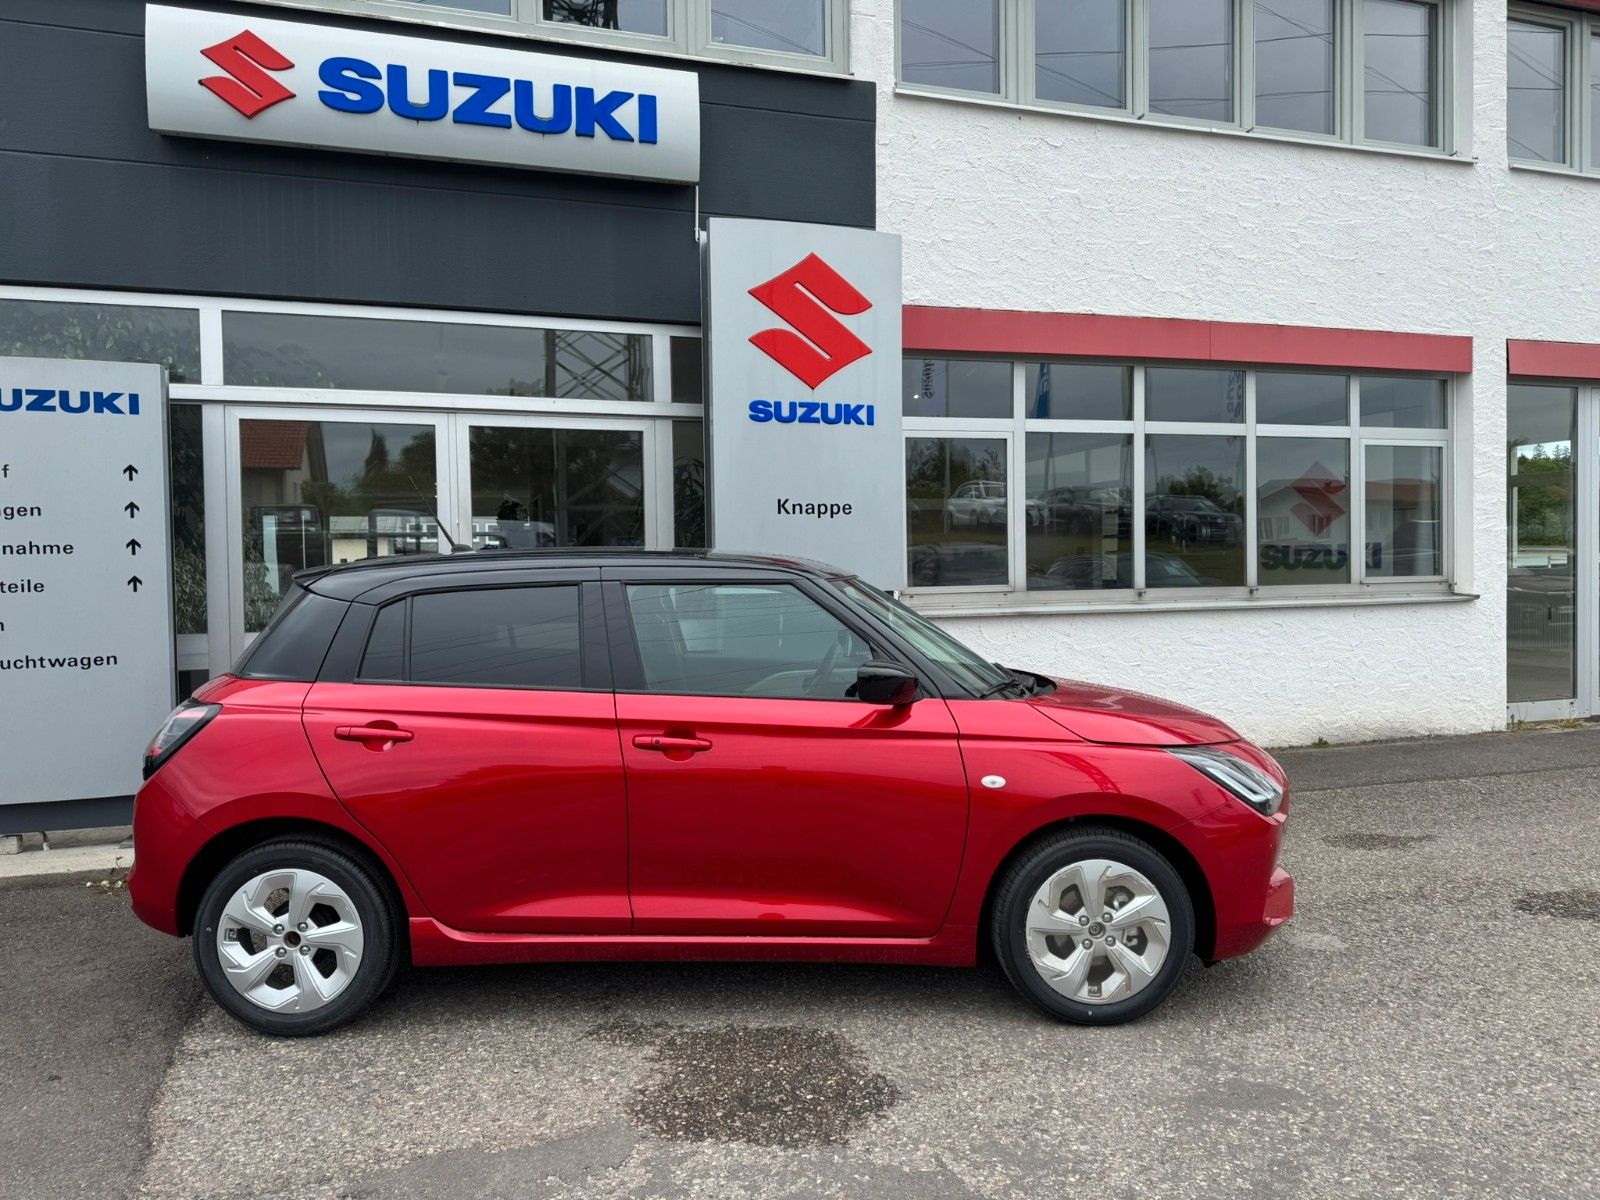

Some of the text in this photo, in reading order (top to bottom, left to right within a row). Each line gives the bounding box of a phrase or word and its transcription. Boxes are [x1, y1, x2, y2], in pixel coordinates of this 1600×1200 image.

[318, 56, 658, 145] SUZUKI
[0, 387, 140, 416] UZUKI
[748, 400, 875, 426] SUZUKI
[0, 505, 42, 520] gen
[777, 498, 853, 518] Knappe
[2, 540, 74, 555] nahme
[0, 578, 45, 594] teile
[0, 655, 118, 670] uchtwagen
